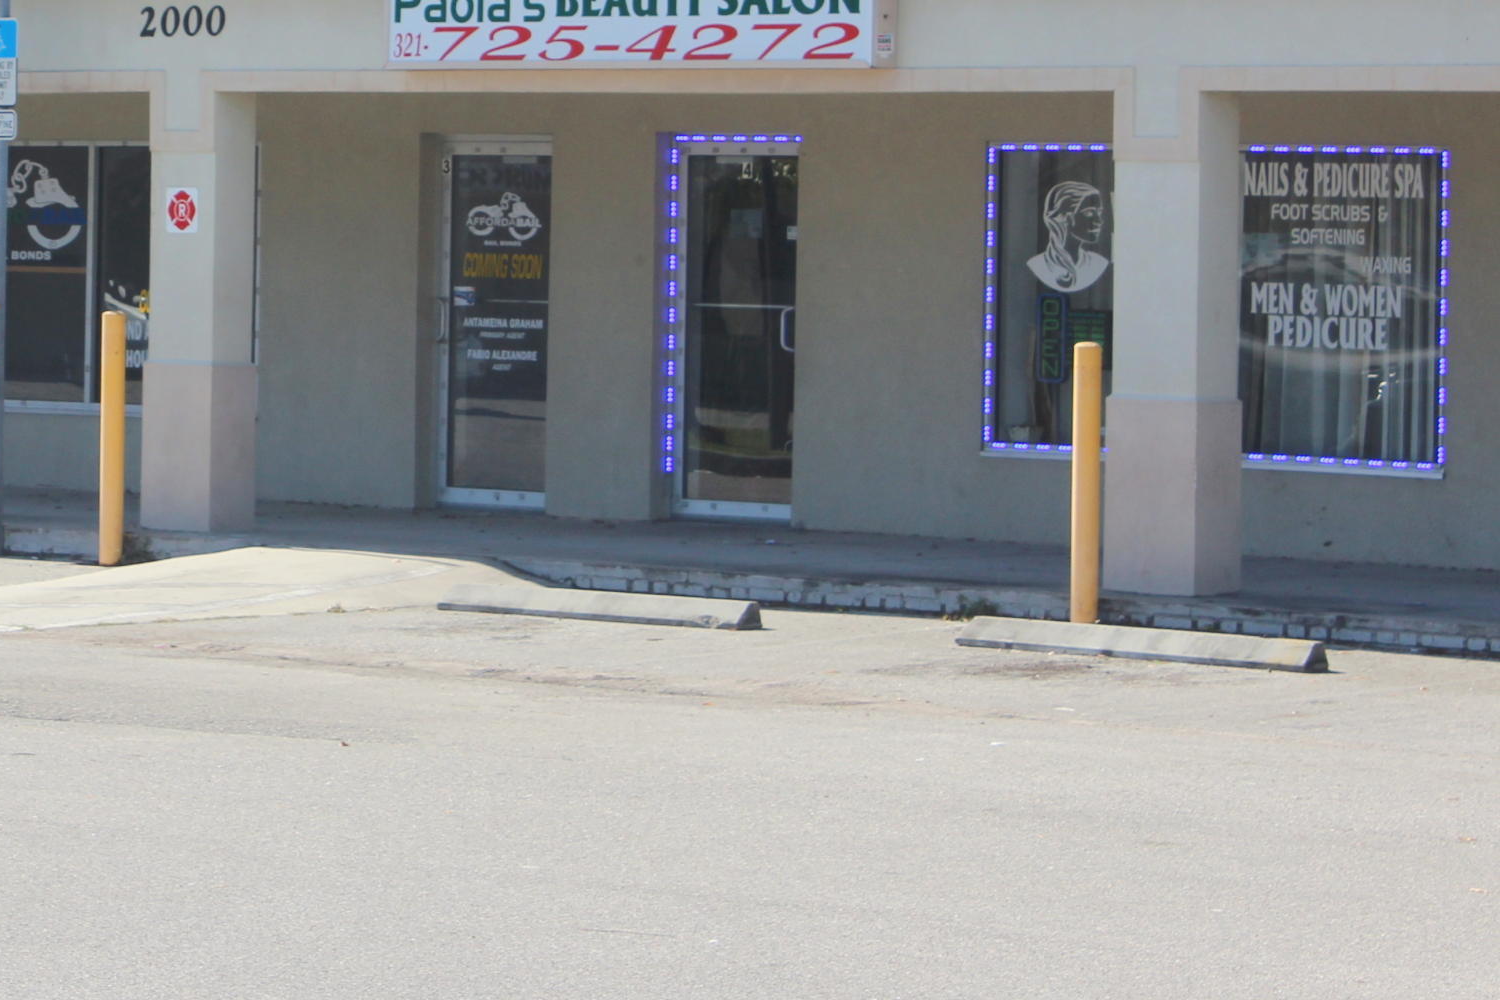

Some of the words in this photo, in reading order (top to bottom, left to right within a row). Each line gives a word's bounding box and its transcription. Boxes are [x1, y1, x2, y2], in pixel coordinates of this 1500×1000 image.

[139, 4, 227, 38] 2000
[443, 159, 451, 174] 3
[744, 163, 751, 177] 4
[1244, 161, 1289, 198] NAILS
[1293, 161, 1309, 197] &
[1313, 162, 1390, 199] PEDICURE
[1394, 163, 1425, 199] SPA
[178, 202, 186, 217] R
[1271, 203, 1309, 221] FOOT
[1311, 204, 1371, 223] SCRUBS
[1377, 205, 1389, 223] &
[1290, 227, 1366, 246] SOFTENING
[11, 250, 52, 261] BONDS
[1361, 255, 1412, 274] WAXING
[463, 252, 509, 278] COMING
[511, 253, 544, 279] SOON
[1250, 281, 1294, 315] MEN
[1300, 282, 1318, 316] &
[1323, 283, 1401, 318] WOMEN
[509, 318, 544, 329] GRAHAM
[1267, 314, 1388, 351] PEDICURE
[1042, 298, 1060, 377] OPEN
[467, 349, 490, 360] FABIO
[491, 349, 538, 362] ALEXANDRE
